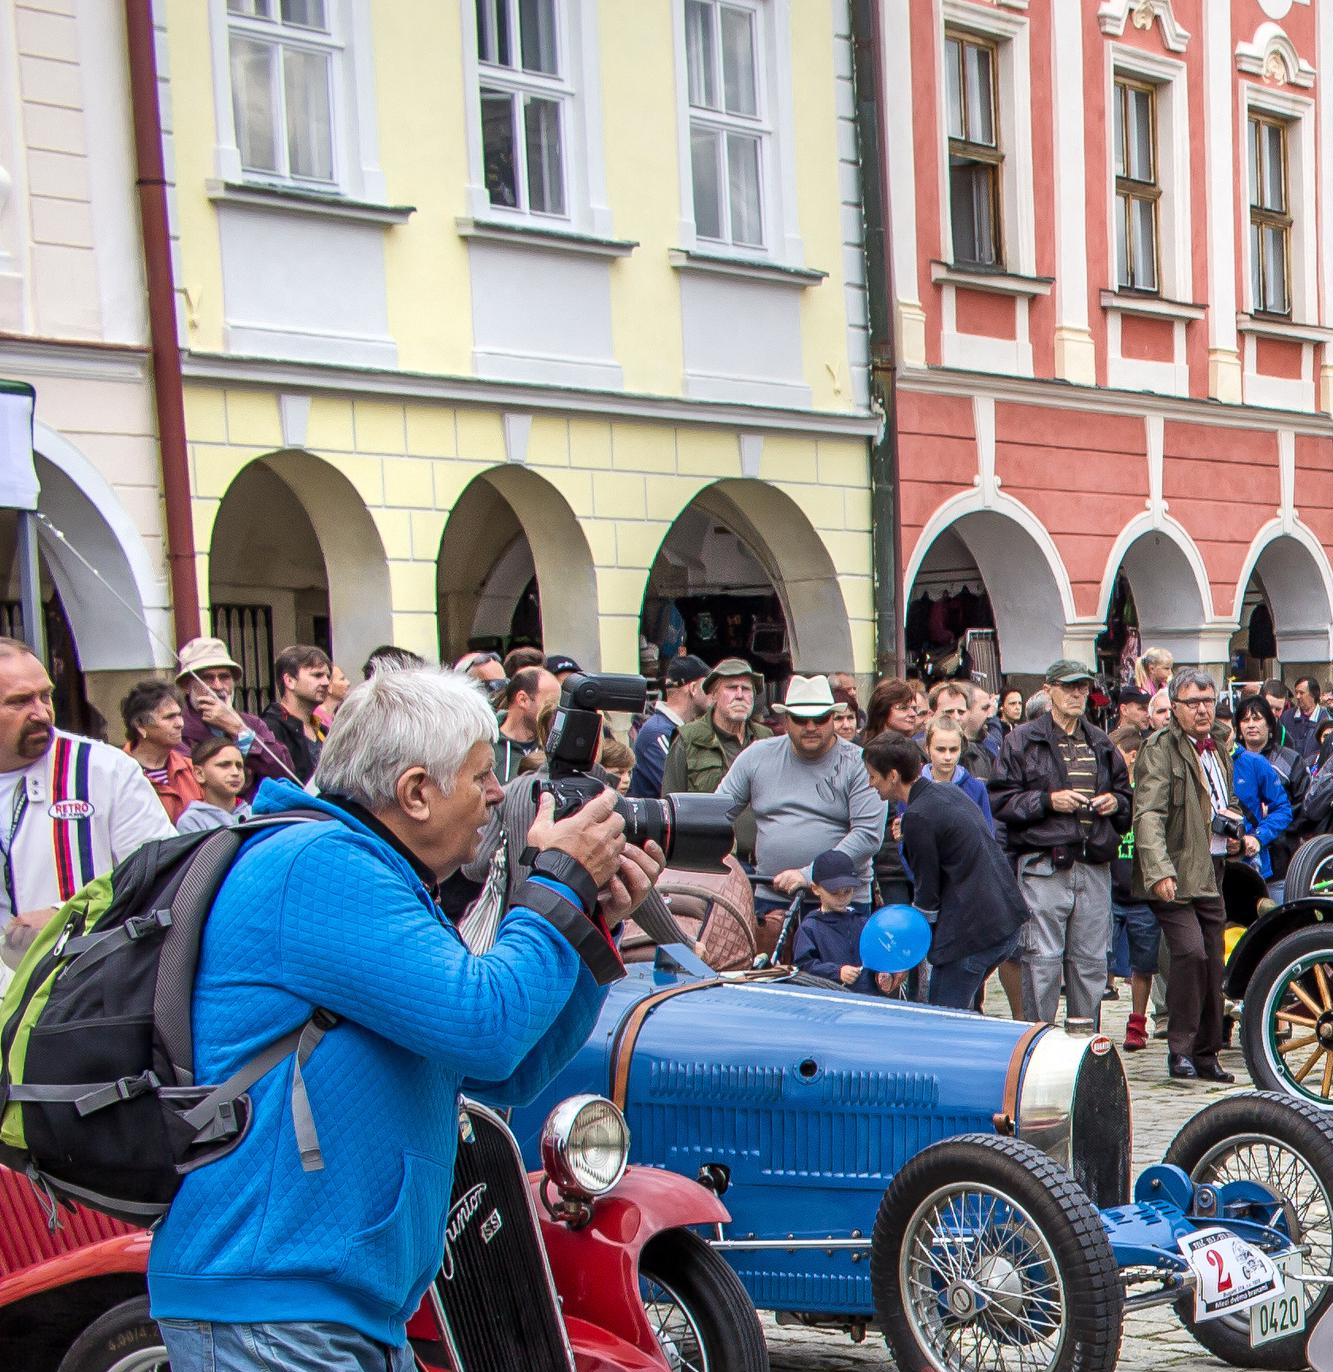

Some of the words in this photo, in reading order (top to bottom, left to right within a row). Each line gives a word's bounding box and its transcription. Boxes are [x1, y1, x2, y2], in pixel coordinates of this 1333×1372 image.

[55, 802, 89, 814] RETRO
[1206, 1250, 1232, 1293] 2
[1260, 1296, 1299, 1336] 0420
